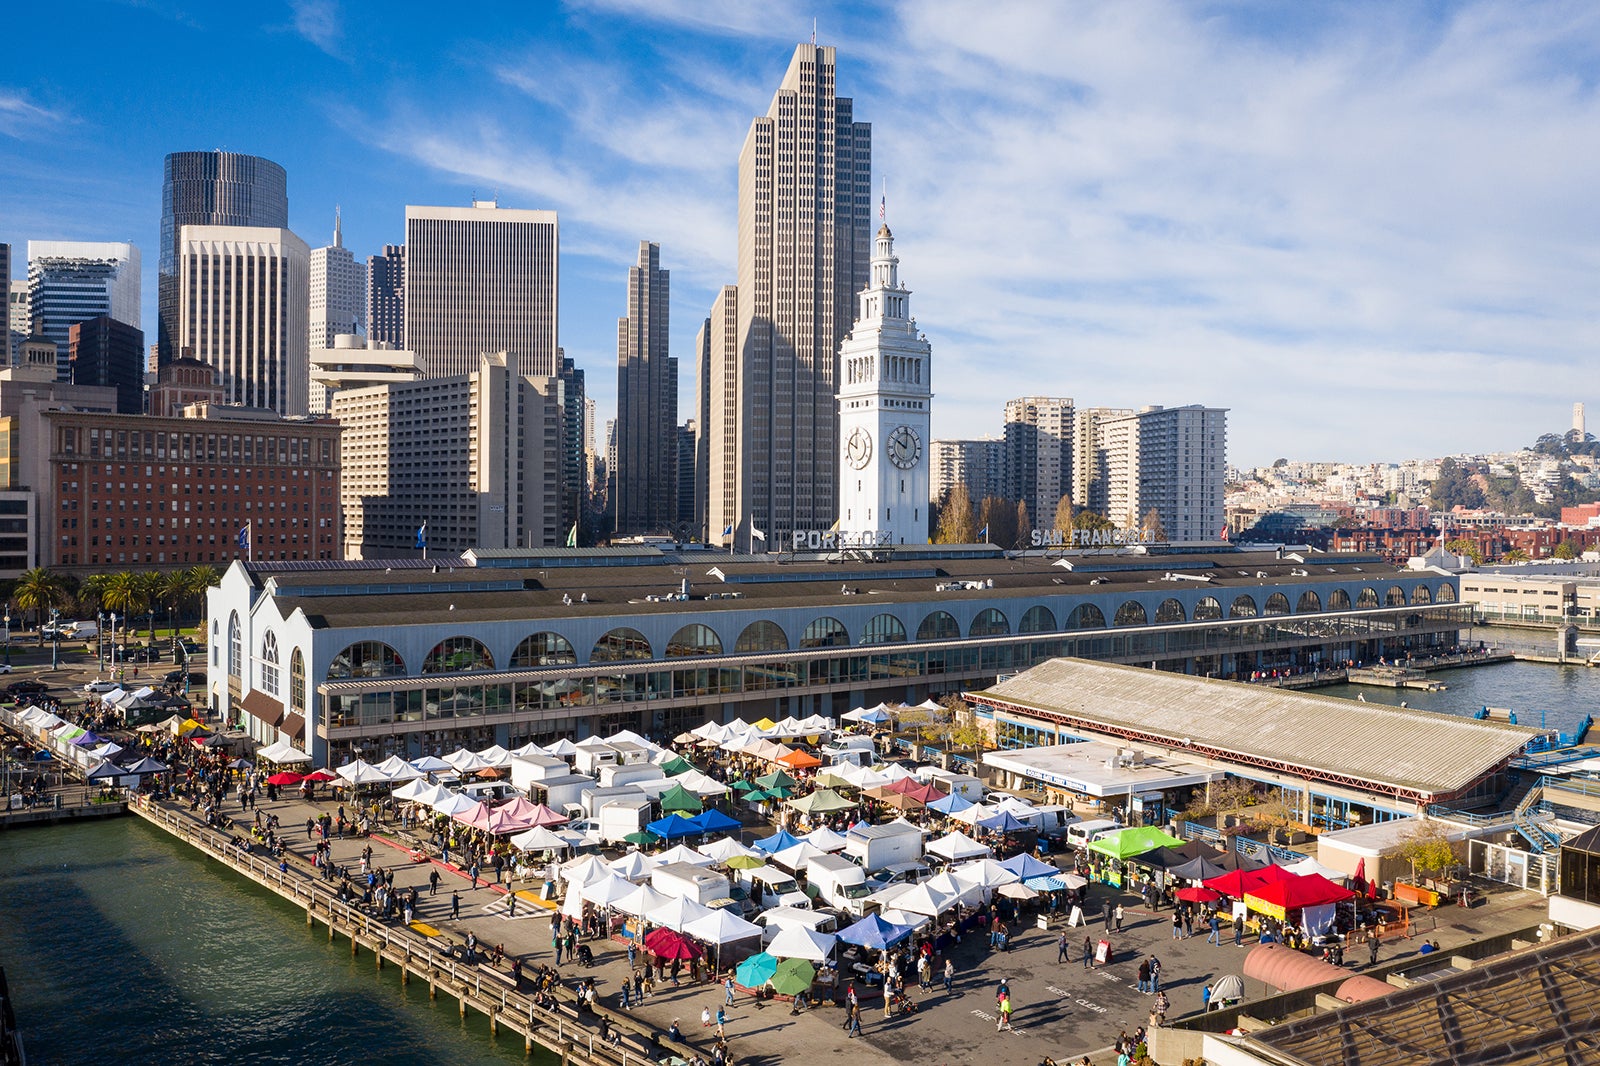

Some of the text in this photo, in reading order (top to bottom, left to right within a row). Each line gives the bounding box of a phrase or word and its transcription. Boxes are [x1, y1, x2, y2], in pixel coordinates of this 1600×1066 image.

[793, 530, 887, 549] PORT OF
[1031, 529, 1155, 546] SAN FRANCISCO
[1098, 971, 1122, 982] FIRE
[1045, 985, 1107, 1013] KEEP CLEAR
[970, 1009, 992, 1021] FIRE
